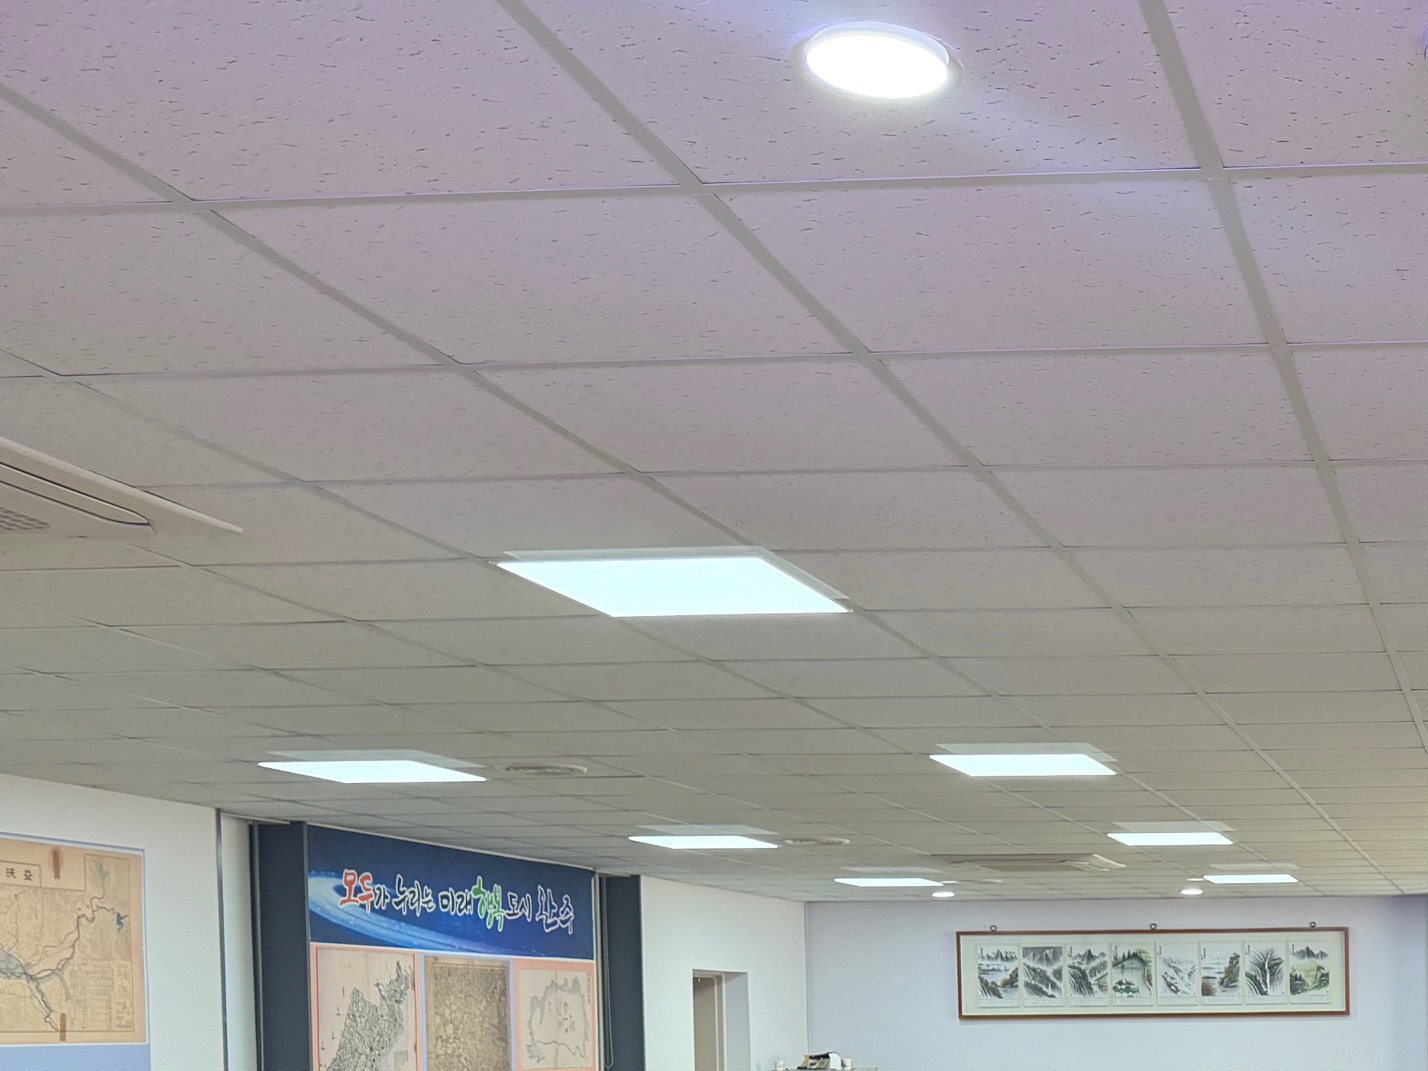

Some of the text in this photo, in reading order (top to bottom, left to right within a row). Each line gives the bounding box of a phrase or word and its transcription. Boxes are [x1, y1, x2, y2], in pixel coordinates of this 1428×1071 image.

[338, 868, 391, 913] 모두가
[392, 874, 436, 917] 누리는
[536, 885, 575, 935] 완주
